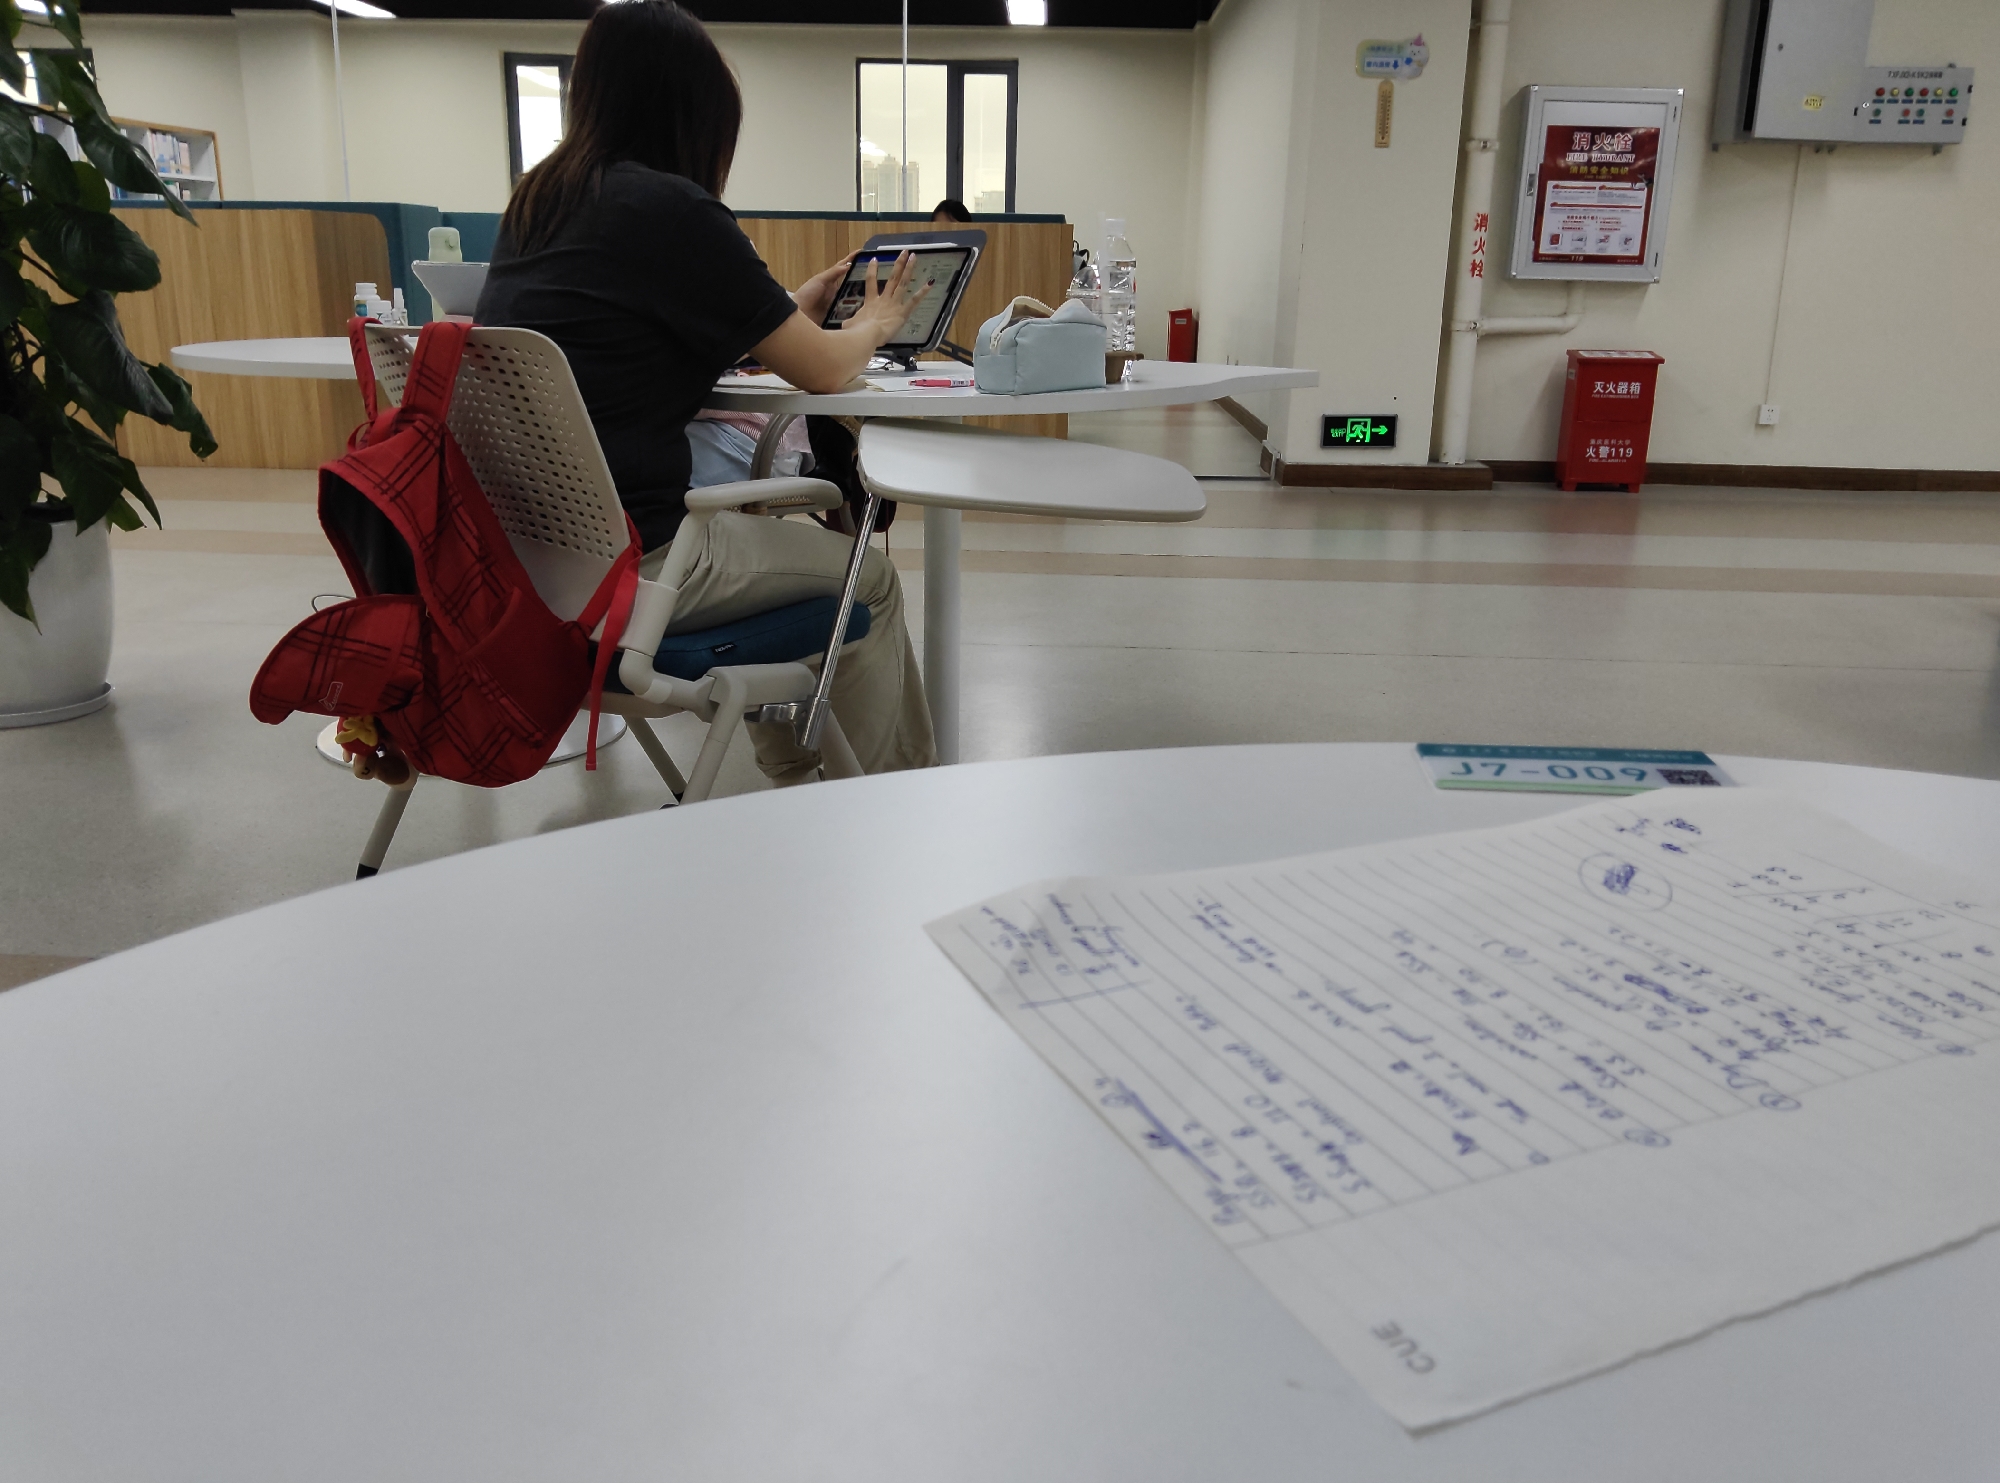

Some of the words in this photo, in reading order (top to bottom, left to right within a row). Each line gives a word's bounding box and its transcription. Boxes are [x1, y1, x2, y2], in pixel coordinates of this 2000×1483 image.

[1572, 132, 1633, 151] 消火栓
[1470, 213, 1488, 278] 消火栓
[1593, 381, 1641, 394] 灭火器箱
[1585, 446, 1633, 458] 火警119
[1451, 762, 1647, 781] J7-009
[1371, 1319, 1435, 1375] CUE
